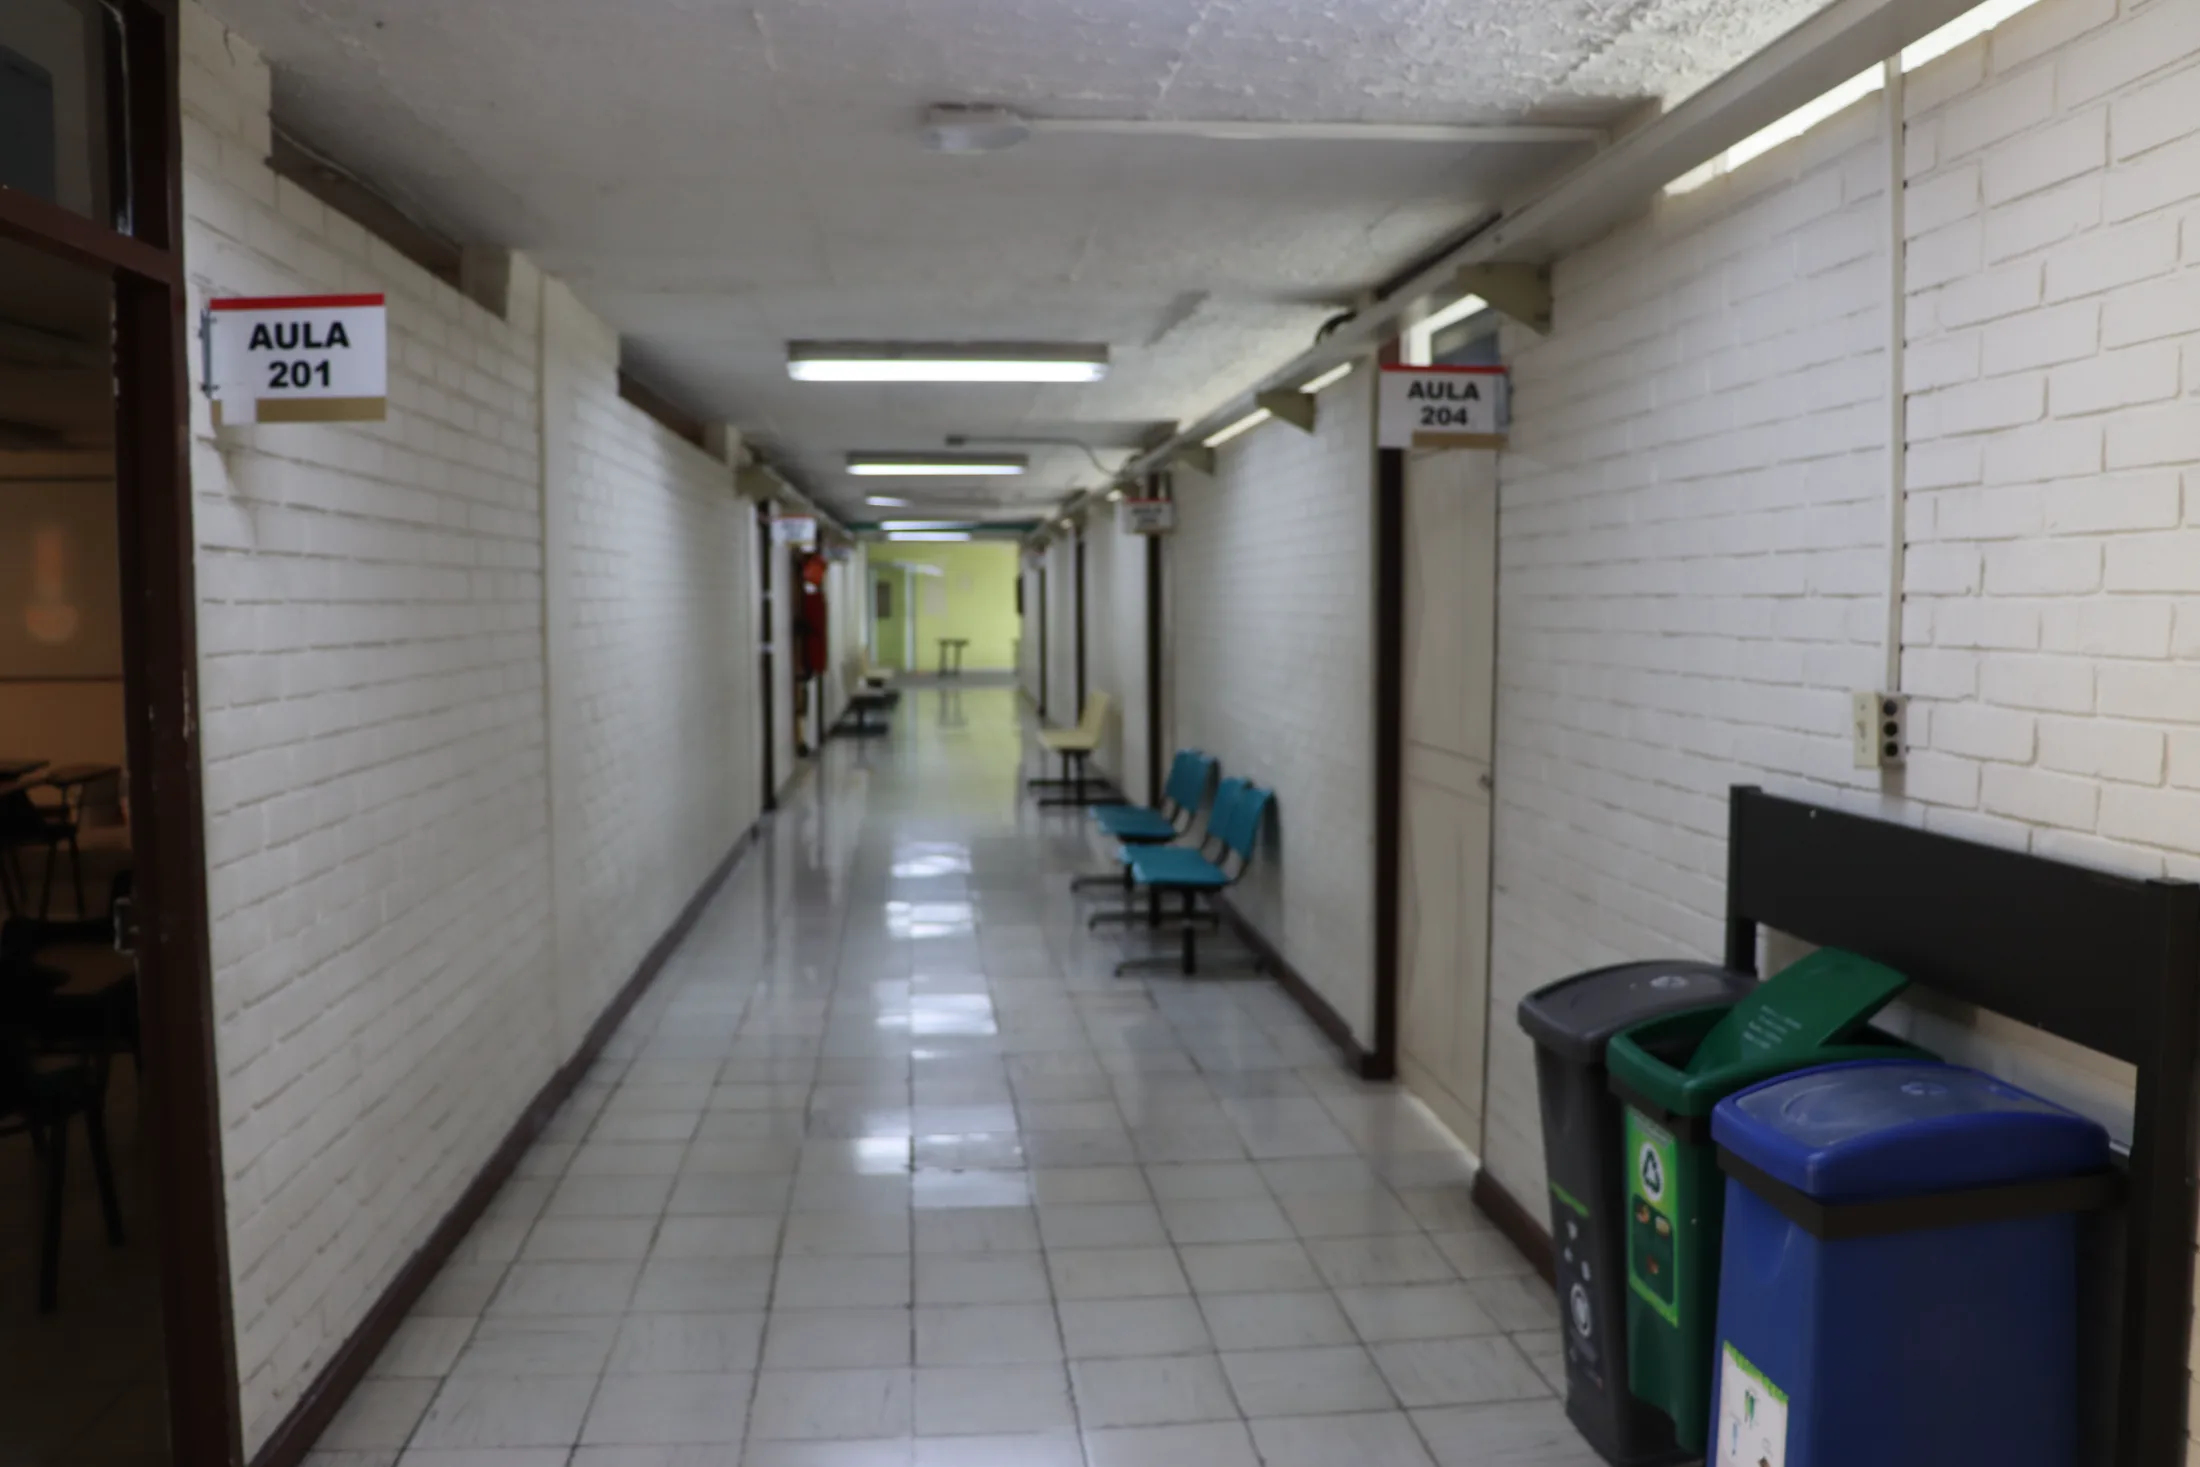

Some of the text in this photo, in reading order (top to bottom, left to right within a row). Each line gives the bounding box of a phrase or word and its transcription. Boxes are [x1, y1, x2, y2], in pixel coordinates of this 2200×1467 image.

[249, 322, 349, 350] AULA
[269, 361, 331, 388] 201
[1408, 381, 1479, 401] AULA
[1421, 406, 1467, 426] 204
